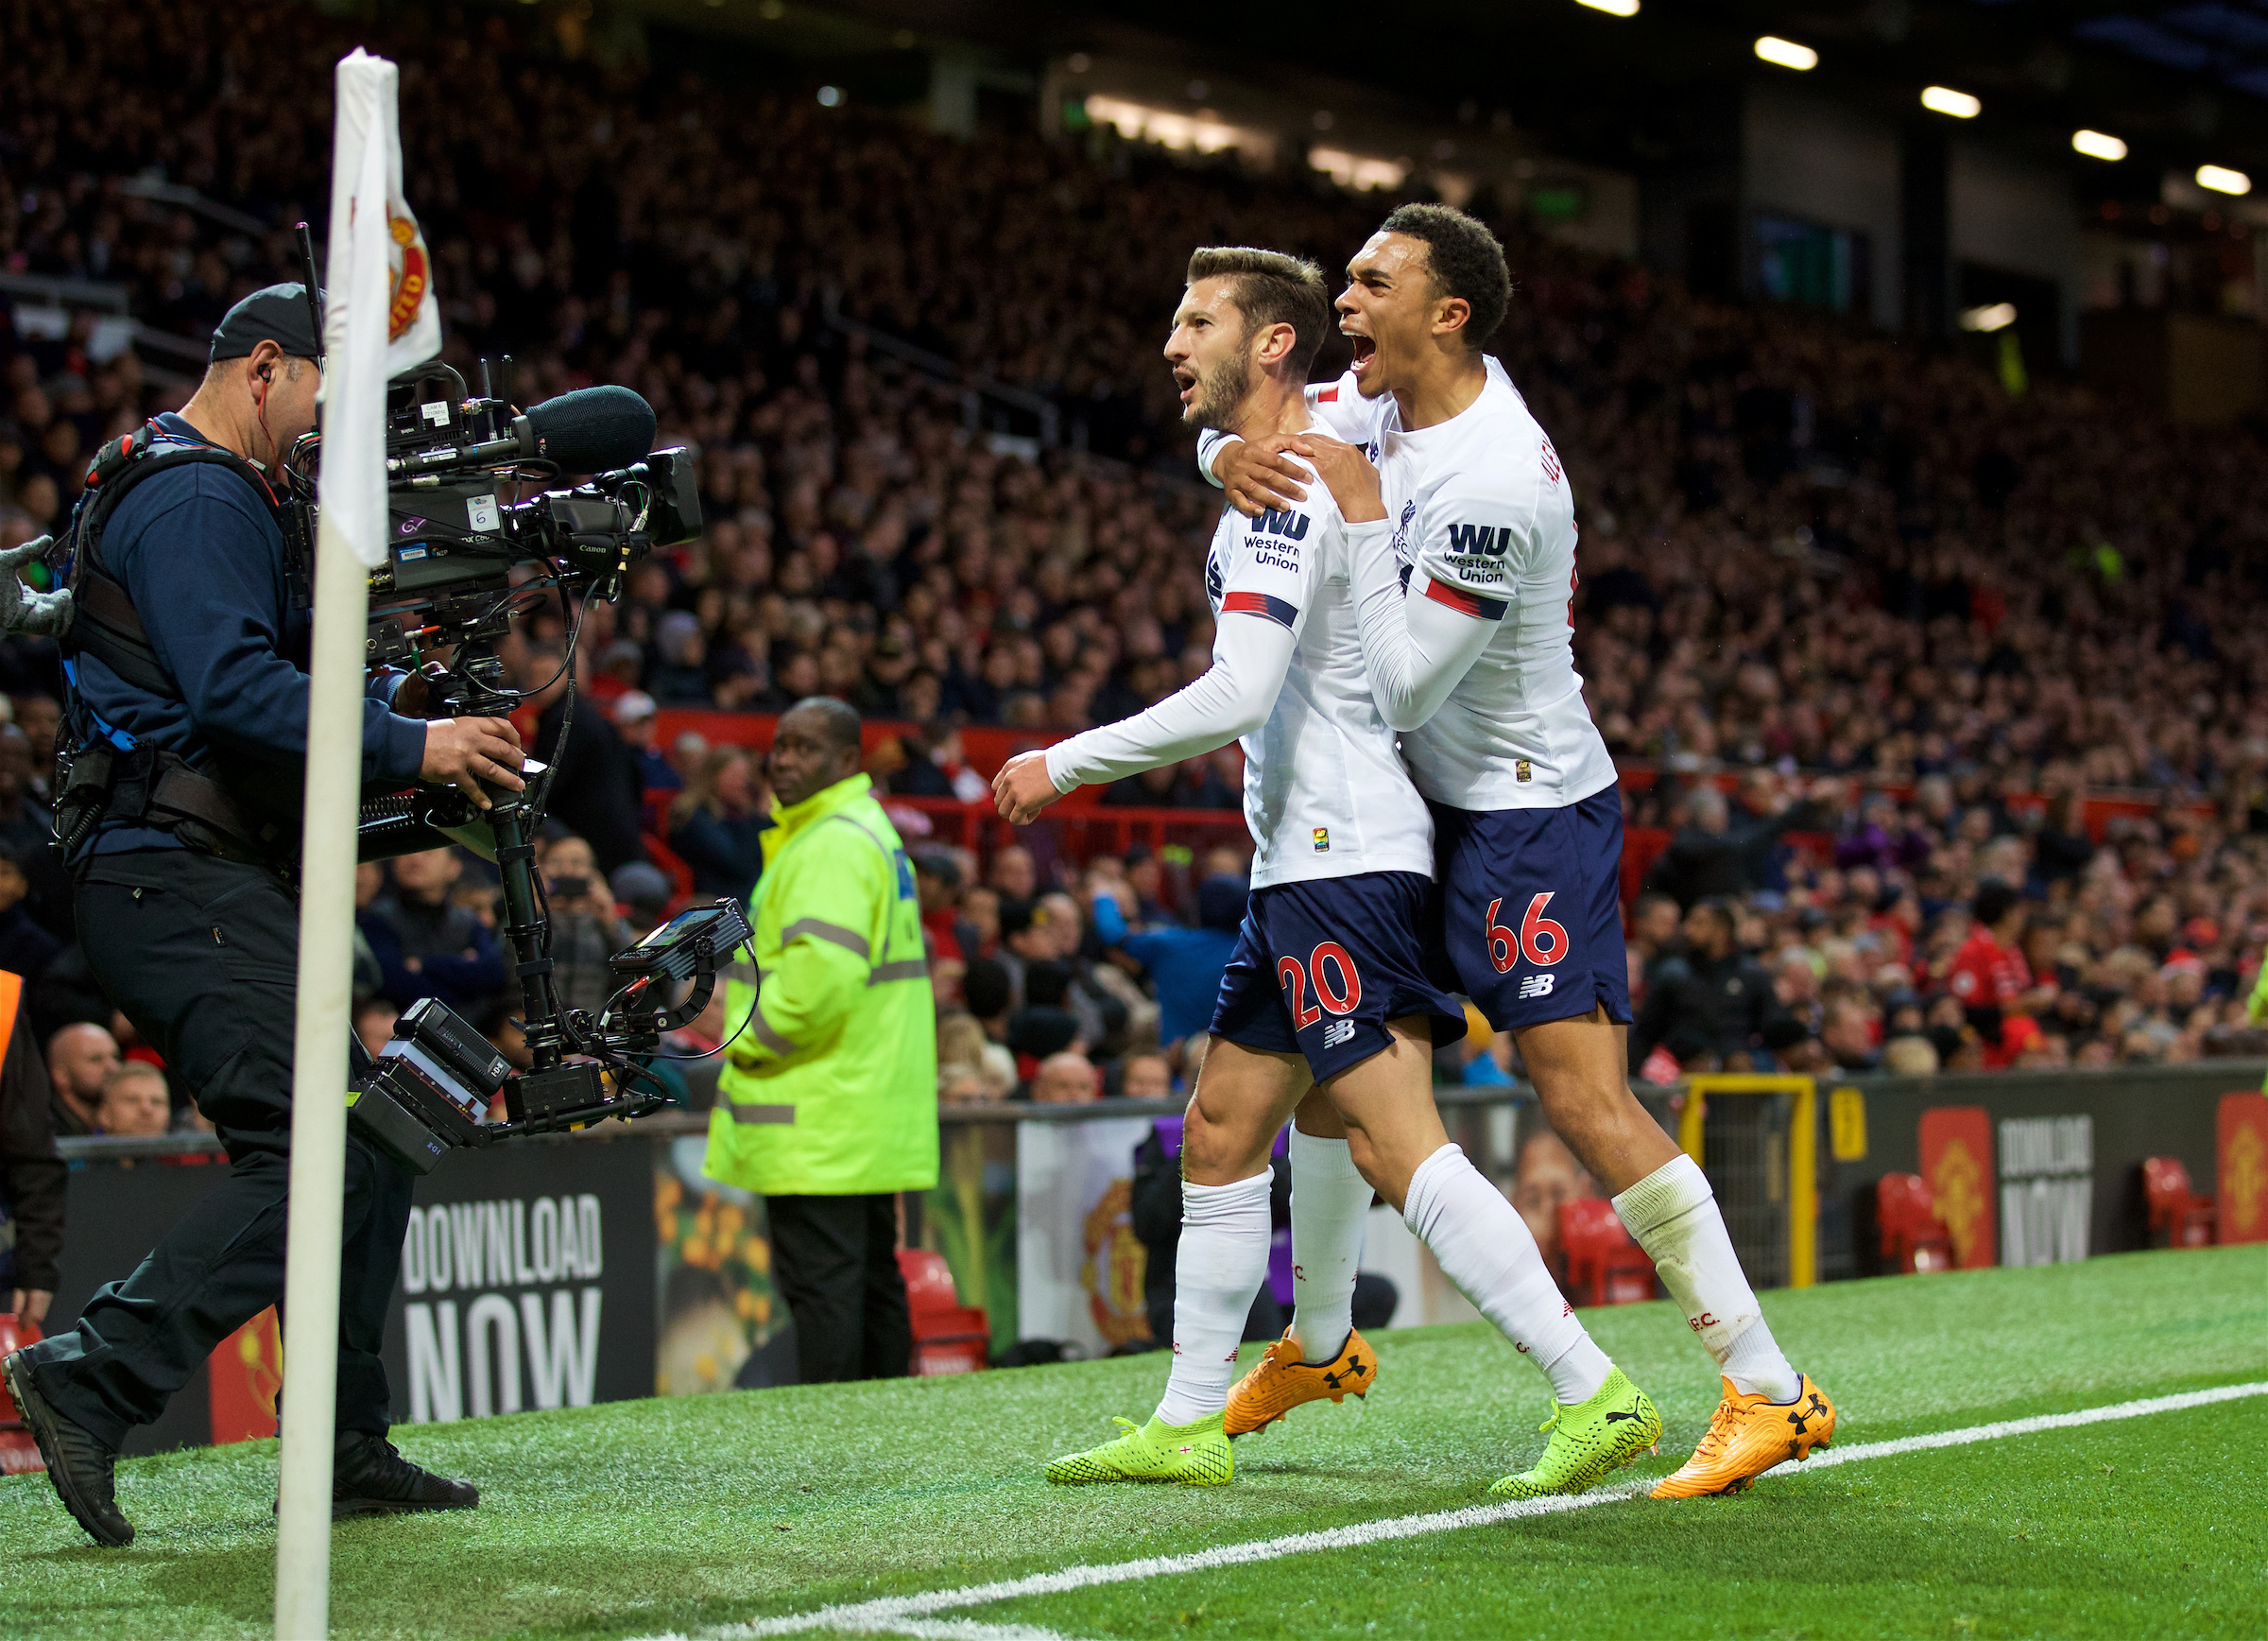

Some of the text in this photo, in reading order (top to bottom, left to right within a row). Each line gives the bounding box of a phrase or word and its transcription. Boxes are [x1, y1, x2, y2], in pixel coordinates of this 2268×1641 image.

[475, 511, 487, 525] 6
[1251, 508, 1311, 541] WU
[579, 544, 607, 554] Canon
[1244, 536, 1300, 559] Western
[1448, 524, 1512, 556] WU
[1256, 550, 1299, 574] Union
[1443, 551, 1505, 570] Western
[1458, 567, 1504, 583] Union
[1486, 891, 1570, 975] 66
[1278, 941, 1362, 1032] 20
[403, 1193, 603, 1294] DOWNLOAD
[404, 1286, 603, 1425] NOW
